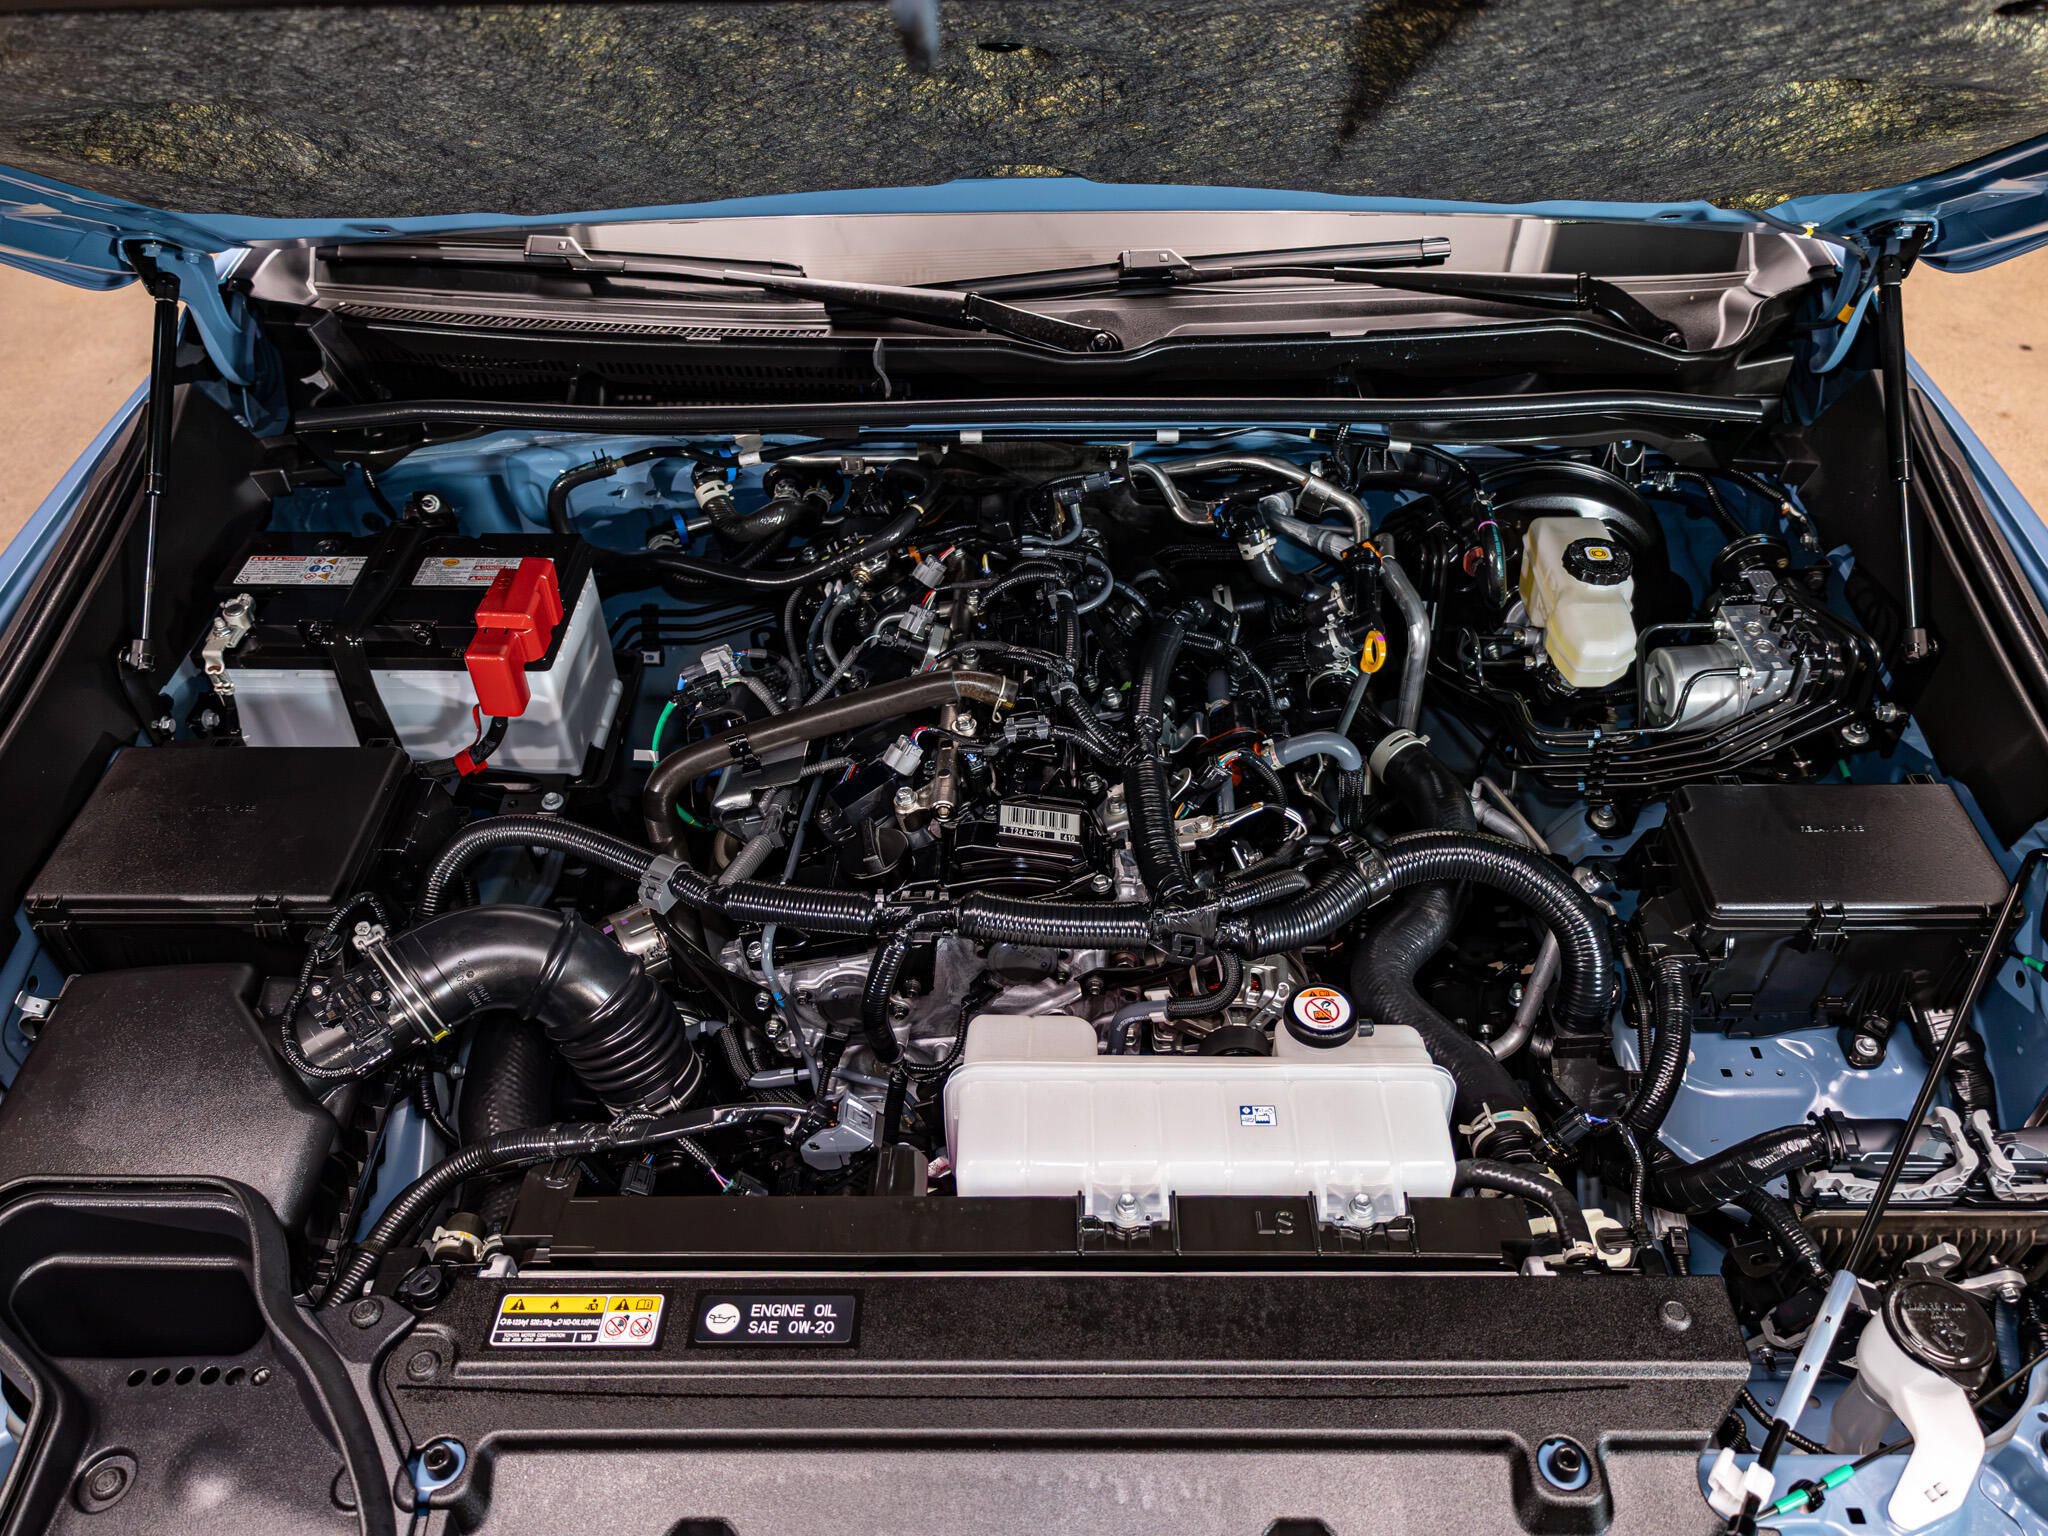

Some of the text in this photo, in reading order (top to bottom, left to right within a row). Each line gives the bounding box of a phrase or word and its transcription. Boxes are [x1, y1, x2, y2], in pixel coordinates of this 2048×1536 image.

[1255, 1210, 1295, 1235] LS
[750, 1304, 837, 1317] ENGINE OIL
[748, 1321, 835, 1334] SAE 0W-20
